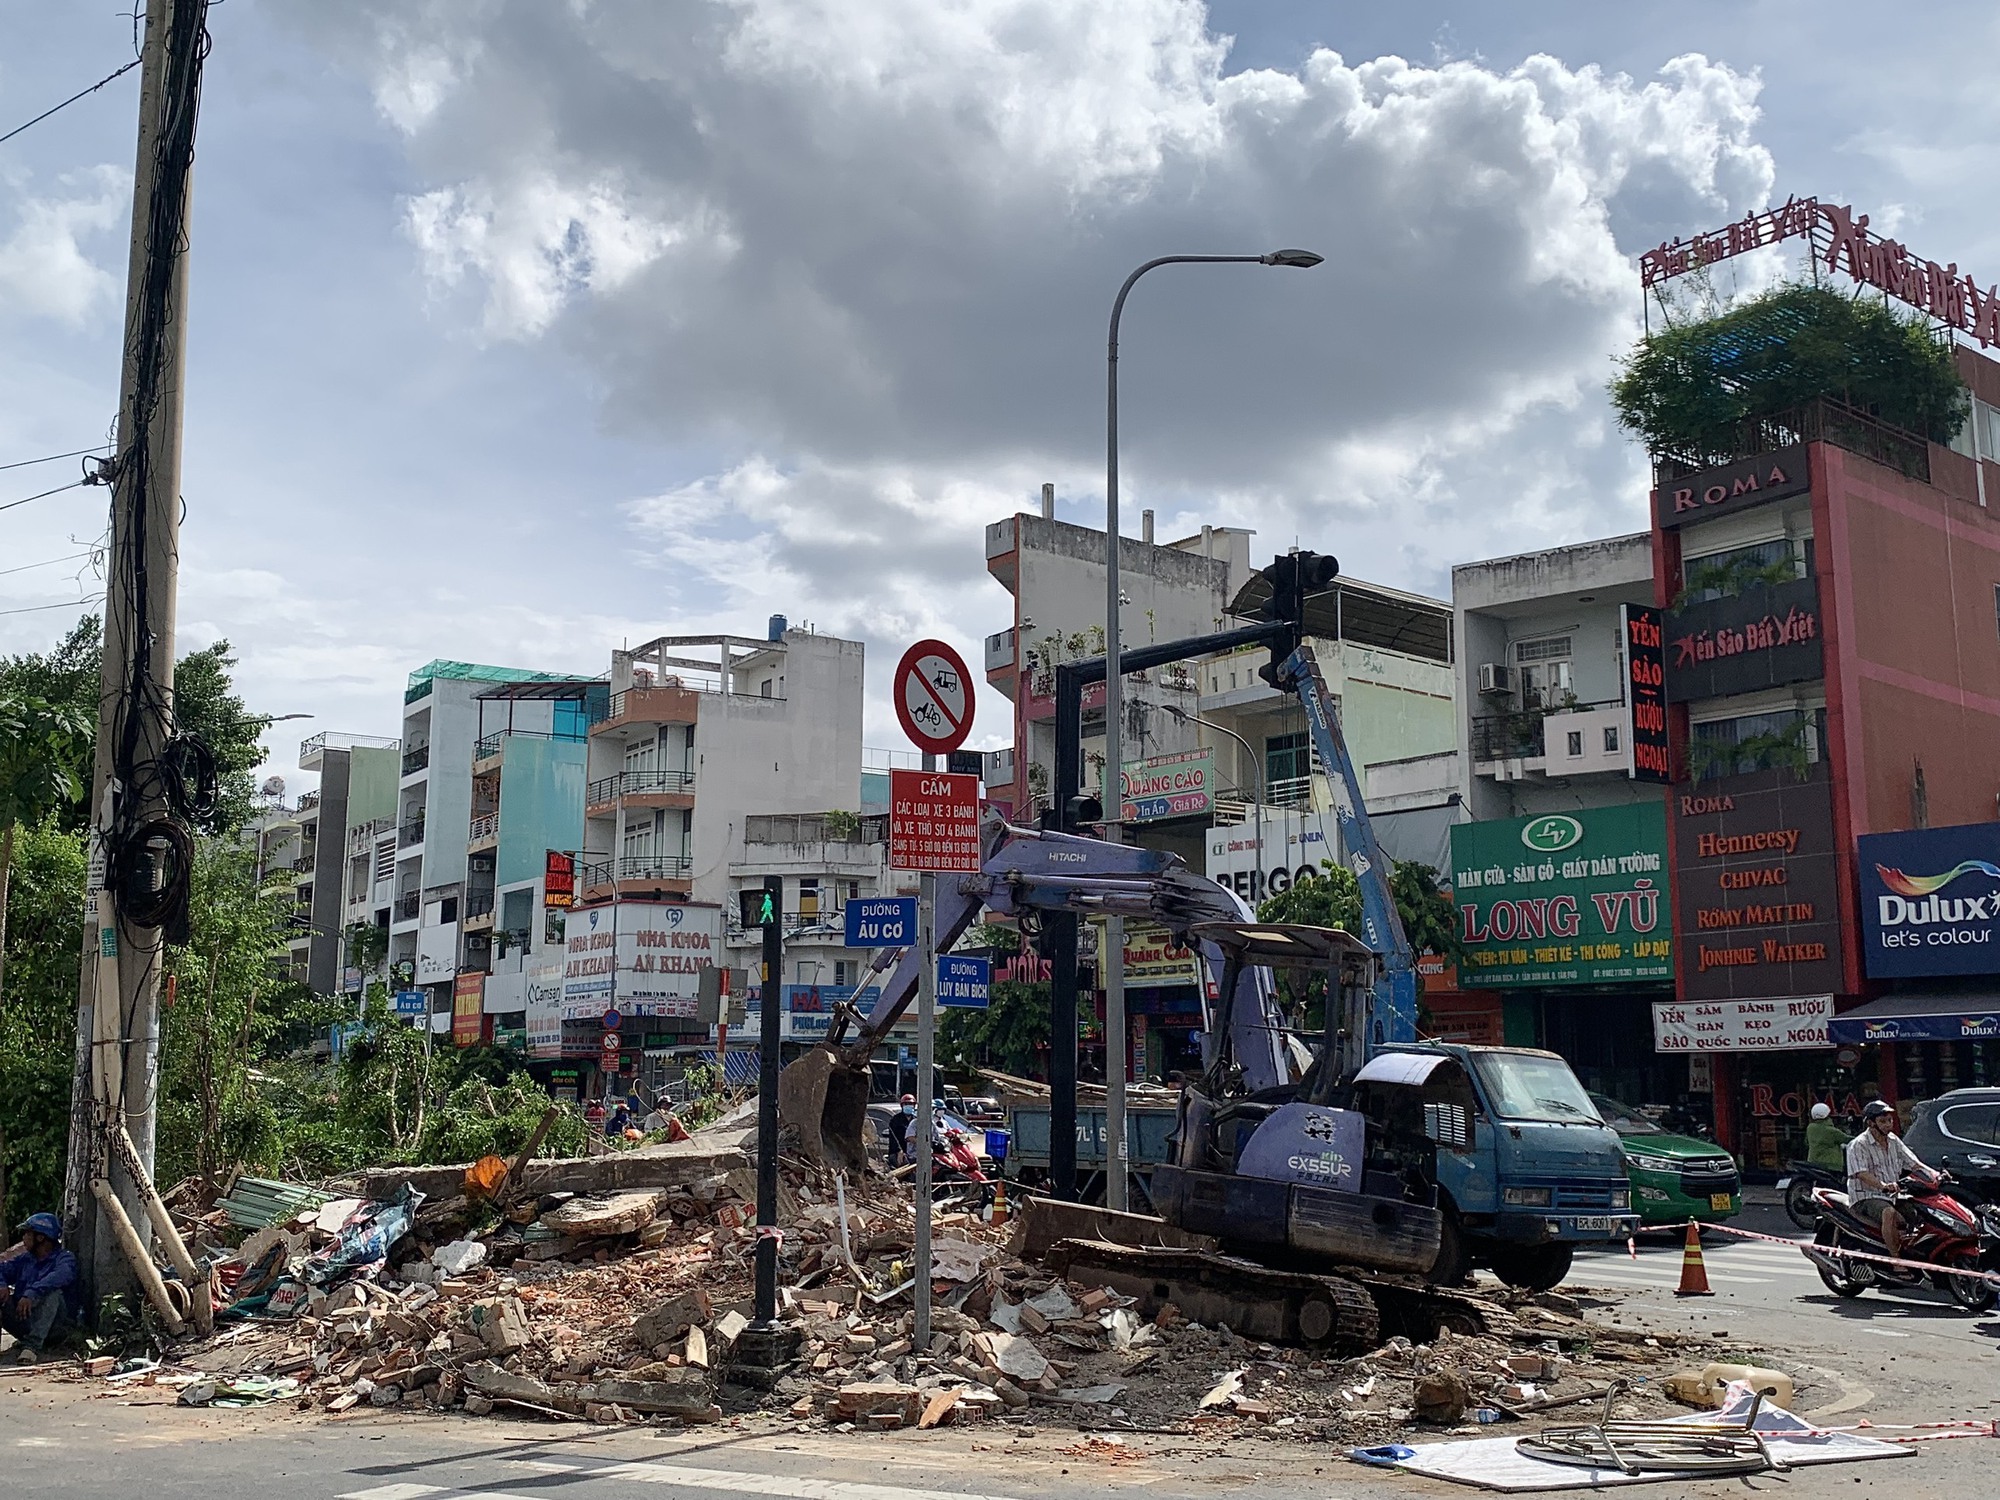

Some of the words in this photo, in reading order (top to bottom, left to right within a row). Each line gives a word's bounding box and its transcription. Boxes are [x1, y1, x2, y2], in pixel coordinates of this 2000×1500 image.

[1672, 464, 1786, 513] ROMA
[1629, 612, 1660, 648] YẾN
[1717, 628, 1744, 656] Sào
[1745, 615, 1774, 650] Đất
[1632, 655, 1662, 686] SÀO
[1635, 699, 1664, 736] RƯỢU
[1635, 742, 1668, 777] NGOẠI
[920, 775, 951, 797] CẤM
[1174, 767, 1205, 790] CÁO
[896, 798, 911, 815] CÁC
[913, 802, 930, 818] LOẠI
[933, 803, 944, 817] XE
[945, 804, 951, 817] 3
[953, 801, 975, 818] BÁNH
[1141, 805, 1151, 817] In
[1152, 800, 1165, 815] Ấn
[1174, 799, 1189, 812] Giá
[1681, 795, 1735, 817] ROMA
[893, 816, 902, 834] VÀ
[904, 821, 914, 834] XE
[917, 819, 932, 836] THÔ
[935, 823, 946, 836] SƠ
[947, 823, 953, 836] 4
[954, 820, 977, 837] BÁNH
[919, 840, 924, 852] 5
[954, 842, 960, 853] 13
[953, 857, 961, 868] 22
[1048, 852, 1087, 862] HITACHI
[1458, 867, 1483, 888] MÀN
[1484, 864, 1505, 886] CỬA
[1513, 861, 1536, 884] SÀN
[1562, 855, 1589, 880] GIẤY
[1592, 855, 1616, 876] DÁN
[1619, 851, 1661, 874] TƯỜNG
[1719, 867, 1788, 890] CHIVAC
[861, 901, 901, 917] ĐƯỜNG
[1461, 896, 1581, 943] LONG
[1591, 878, 1660, 934] VŨ
[1878, 894, 1990, 926] Dulux
[858, 919, 878, 939] ÂU
[882, 920, 903, 939] CƠ
[1881, 930, 1921, 947] let's
[1926, 927, 1992, 946] colour
[568, 936, 588, 954] NHA
[636, 930, 667, 948] NHA
[671, 932, 711, 950] KHOA
[1580, 944, 1594, 960] THI
[565, 959, 581, 979] AN
[633, 954, 656, 972] AN
[950, 962, 978, 976] ĐƯỜNG
[954, 978, 969, 997] BÁN
[970, 979, 988, 999] BÍCH
[1659, 1006, 1685, 1023] YẾN
[1695, 1004, 1722, 1015] SÂM
[1738, 1002, 1775, 1013] BÁNH
[1787, 999, 1825, 1019] RƯỢU
[1696, 1021, 1724, 1031] HÀN
[1744, 1020, 1771, 1031] KẸO
[1865, 1029, 1896, 1039] Dulux
[1961, 1025, 1993, 1036] Dulux
[1663, 1033, 1688, 1048] SÀO
[1696, 1035, 1731, 1048] QUỐC
[1739, 1036, 1780, 1047] NGOẠI
[1287, 1155, 1352, 1178] EX55UR
